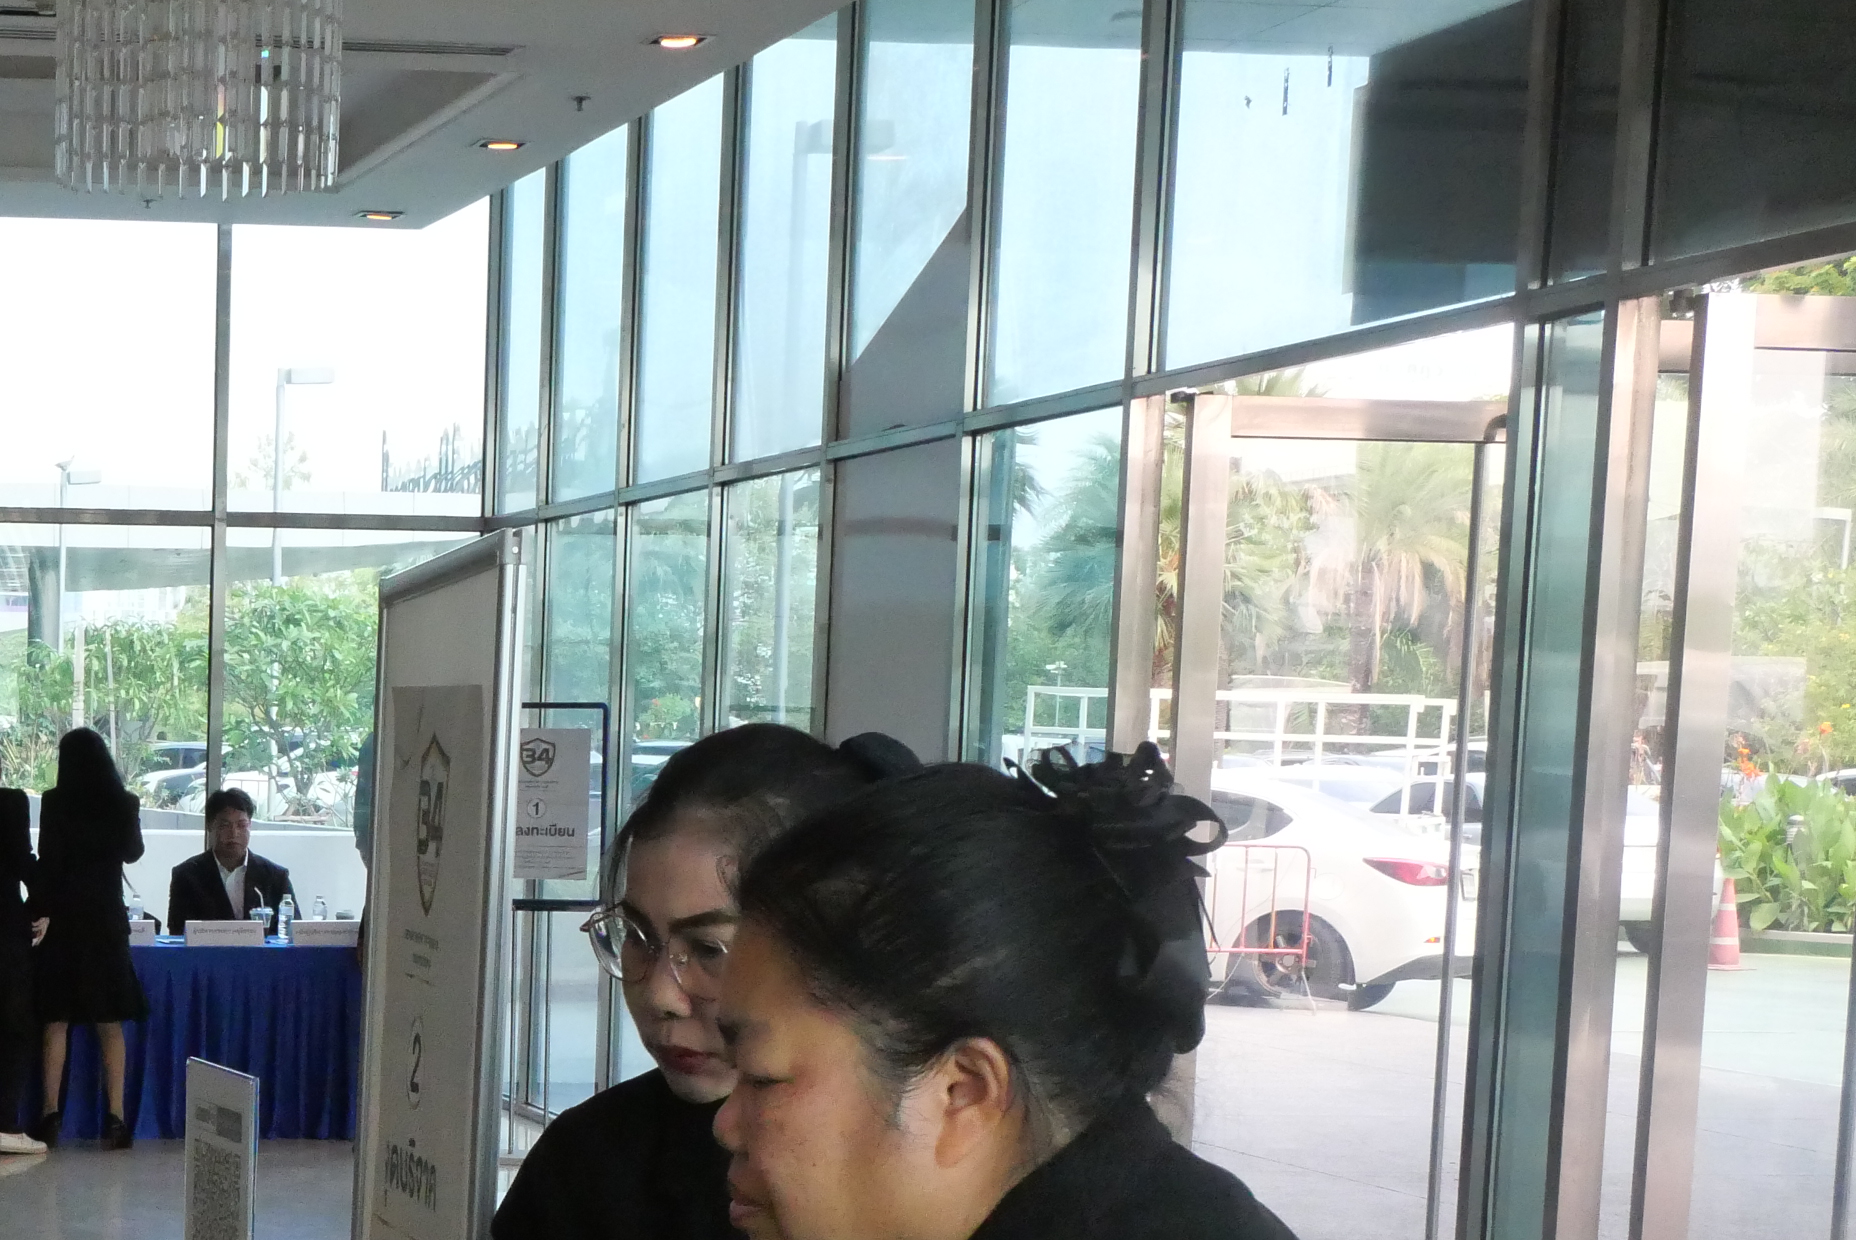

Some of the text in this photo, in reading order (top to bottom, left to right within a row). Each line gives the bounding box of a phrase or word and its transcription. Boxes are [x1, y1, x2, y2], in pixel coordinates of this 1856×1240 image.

[522, 748, 552, 765] 34
[531, 801, 540, 817] 1
[416, 780, 444, 858] 34
[515, 822, 576, 839] ลงทะเบียน
[409, 1032, 422, 1094] 2
